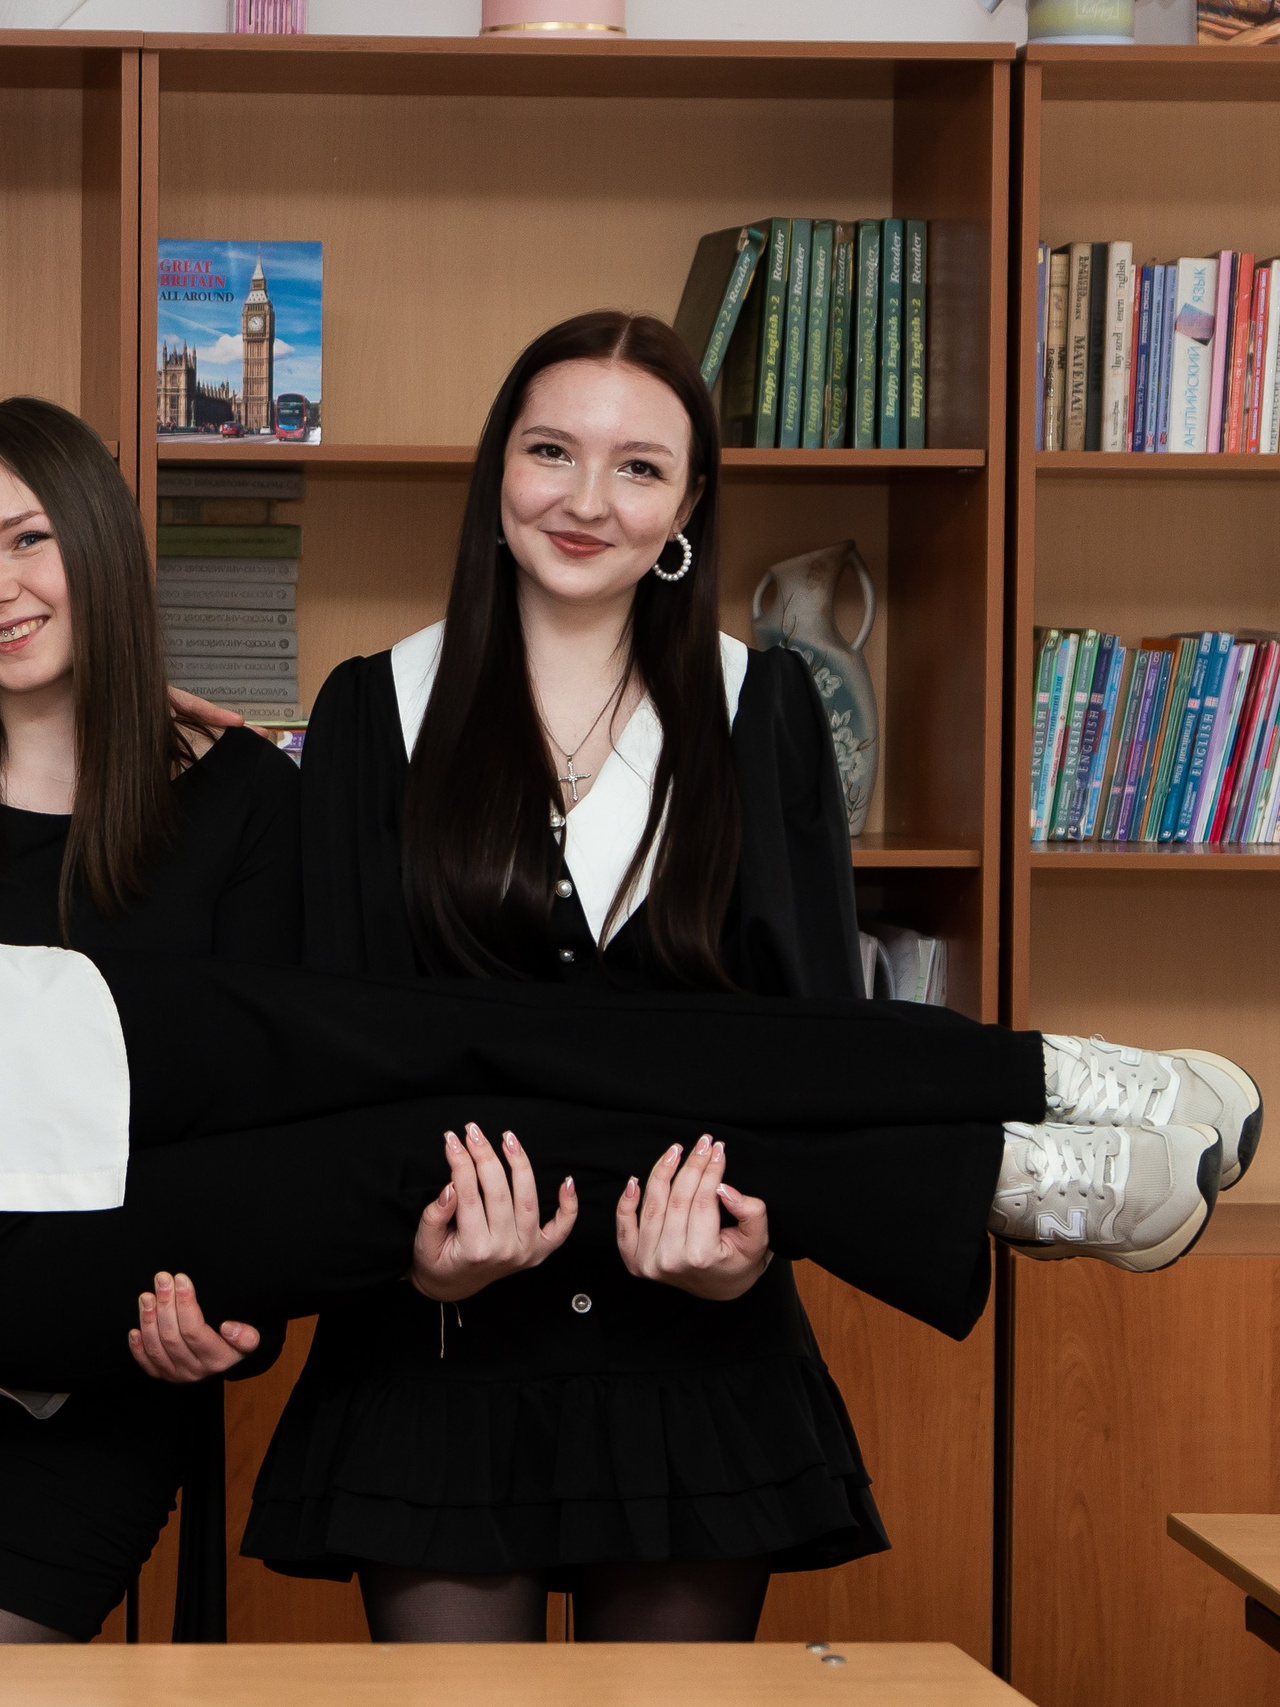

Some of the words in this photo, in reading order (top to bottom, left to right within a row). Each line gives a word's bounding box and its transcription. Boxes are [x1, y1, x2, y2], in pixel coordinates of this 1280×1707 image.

[160, 259, 213, 274] GREAT
[160, 274, 226, 288] BRITAIN
[772, 230, 785, 282] Reader
[794, 244, 806, 296] Reader
[815, 246, 826, 298] Reader
[837, 244, 846, 296] Reader
[865, 244, 878, 298] Reader
[890, 232, 902, 284] Reader
[911, 232, 922, 284] Reader
[159, 290, 181, 302] ALL
[182, 292, 234, 303] AROUND
[724, 311, 732, 322] 2
[729, 253, 751, 304] Reader
[772, 295, 780, 304] 2
[791, 305, 802, 315] 2
[812, 307, 823, 318] 2
[834, 307, 844, 318] 2
[863, 307, 873, 318] 2
[911, 298, 921, 306] 2
[767, 313, 780, 366] English
[789, 325, 802, 378] English
[832, 327, 843, 379] English
[861, 328, 872, 381] English
[888, 316, 900, 368] English
[911, 317, 922, 368] English
[1183, 346, 1201, 447] АНГЛИЙСКИЙ
[1193, 267, 1206, 303] ЯЗЫК
[762, 370, 774, 415] Happy
[886, 371, 898, 418] Happy
[910, 372, 922, 418] Happy
[186, 638, 276, 649] РУССКО-АНГЛИЙСКИЙ
[186, 662, 276, 672] РУССКО-АНГЛИЙСКИЙ
[1139, 653, 1147, 664] 6
[1153, 653, 1160, 663] 8
[250, 685, 288, 696] СЛОВАРЬ
[1031, 710, 1048, 775] ENGLISH
[1065, 711, 1083, 775] ENGLISH
[1081, 710, 1099, 773] ENGLISH
[1179, 713, 1196, 763] Английский
[1191, 714, 1213, 776] ENGLISH
[1173, 765, 1182, 784] язык
